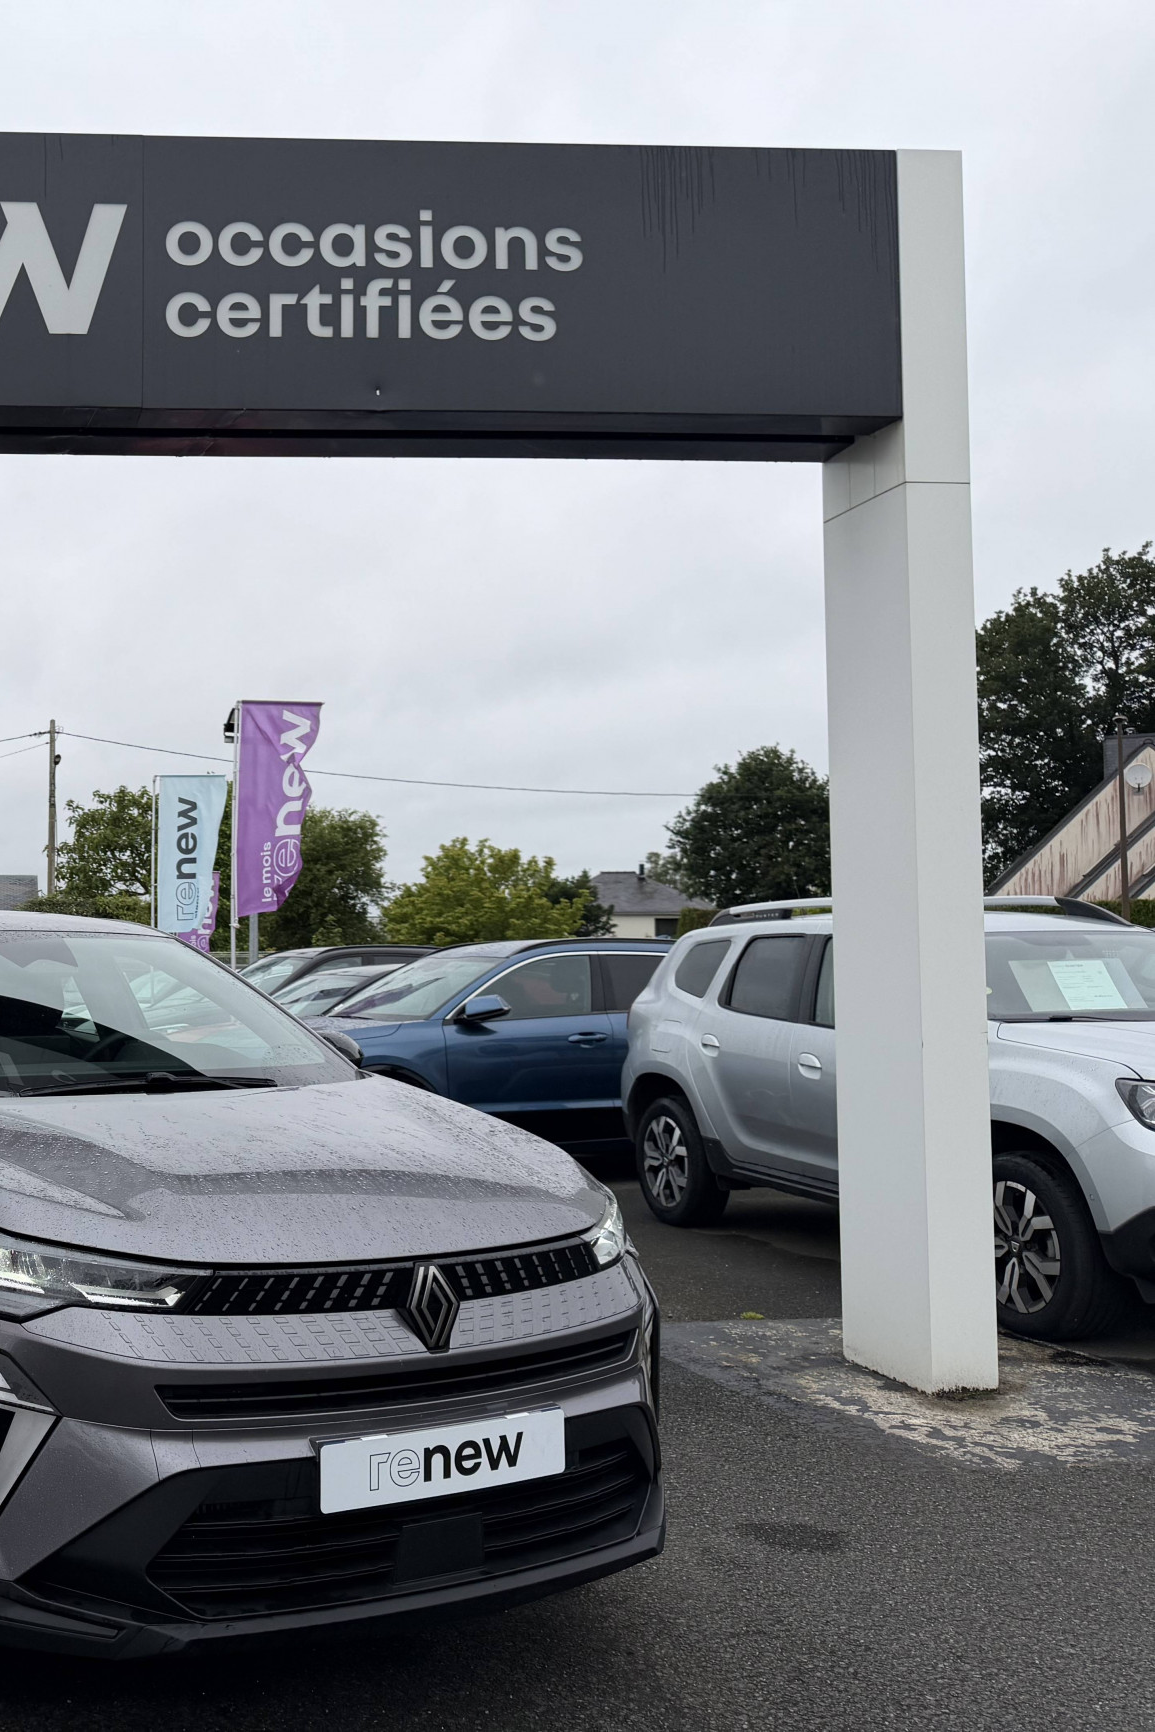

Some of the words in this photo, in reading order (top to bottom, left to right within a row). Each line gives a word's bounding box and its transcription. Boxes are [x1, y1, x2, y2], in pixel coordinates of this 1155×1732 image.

[165, 209, 584, 272] occasions
[165, 277, 558, 342] certifiées
[176, 796, 198, 921] renew
[260, 841, 272, 884] mois
[261, 886, 272, 902] le
[369, 1431, 524, 1492] renew
